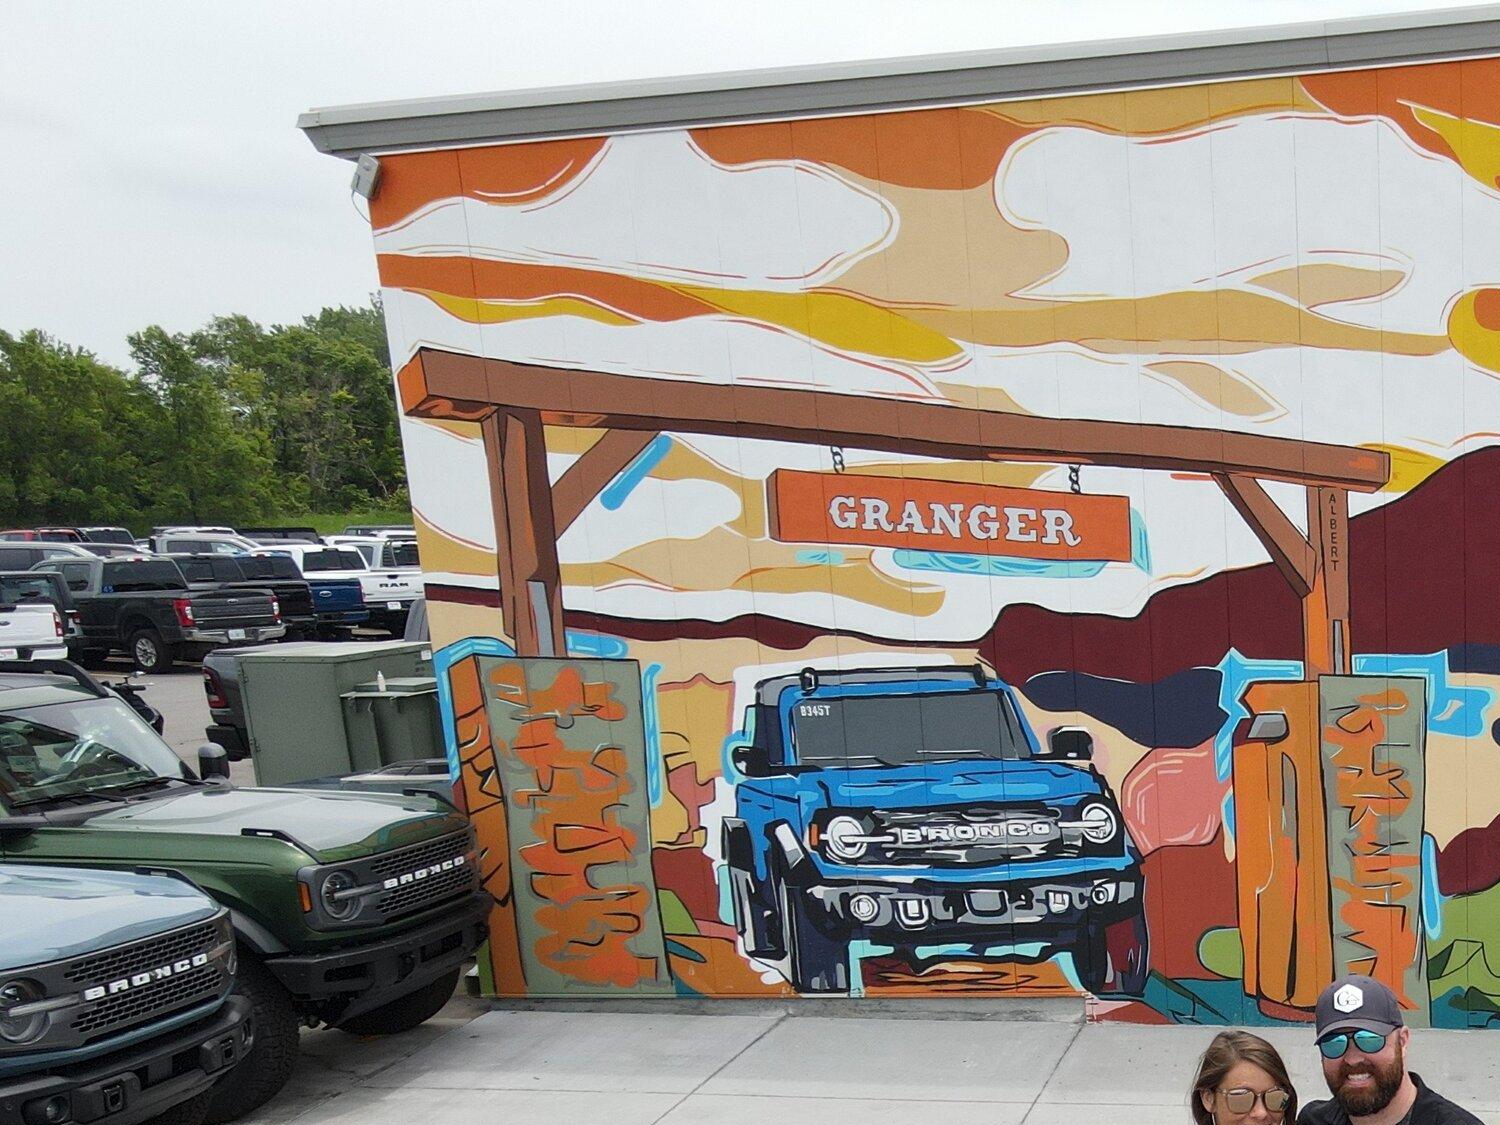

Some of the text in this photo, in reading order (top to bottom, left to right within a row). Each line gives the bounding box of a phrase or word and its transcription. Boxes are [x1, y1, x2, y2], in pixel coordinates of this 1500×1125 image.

[829, 495, 1082, 547] GRANGER
[1329, 493, 1339, 572] ALBERT
[900, 822, 1051, 843] BRONCO
[383, 855, 465, 890] BRONCO
[84, 953, 208, 1001] BRONCO
